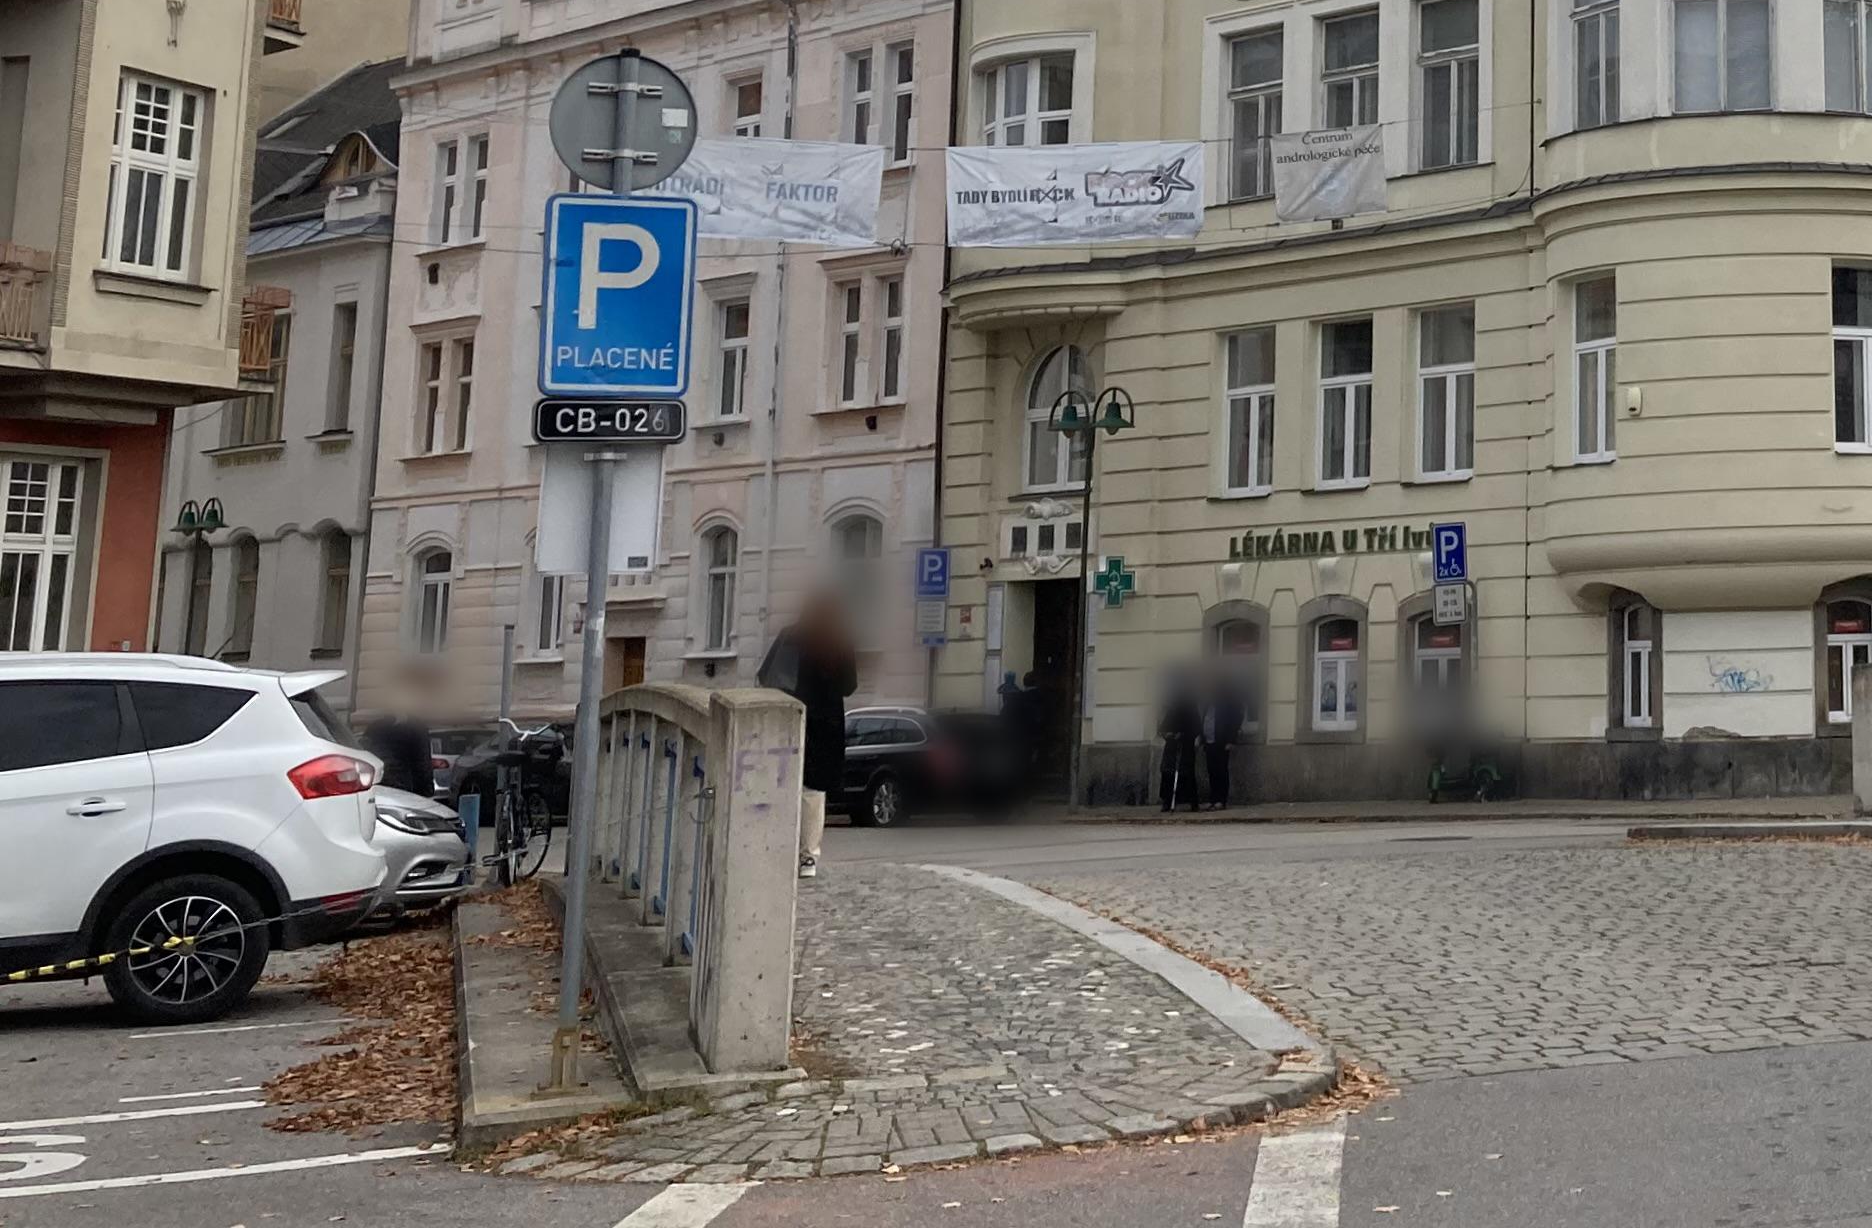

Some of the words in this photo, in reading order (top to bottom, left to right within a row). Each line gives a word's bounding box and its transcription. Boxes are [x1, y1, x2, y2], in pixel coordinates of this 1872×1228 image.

[1301, 131, 1353, 145] Centrum
[1276, 147, 1352, 163] andrologické
[765, 180, 839, 204] FAKTOR
[956, 189, 988, 204] TADY
[991, 187, 1028, 204] BYDLÍ
[578, 221, 661, 330] P
[556, 342, 675, 370] PLACENÉ
[555, 407, 665, 434] CB-026
[1229, 528, 1337, 560] LÉKÁRNA
[1342, 529, 1358, 553] U
[1363, 525, 1398, 551] Tří
[1440, 530, 1459, 564] P
[923, 554, 942, 582] P
